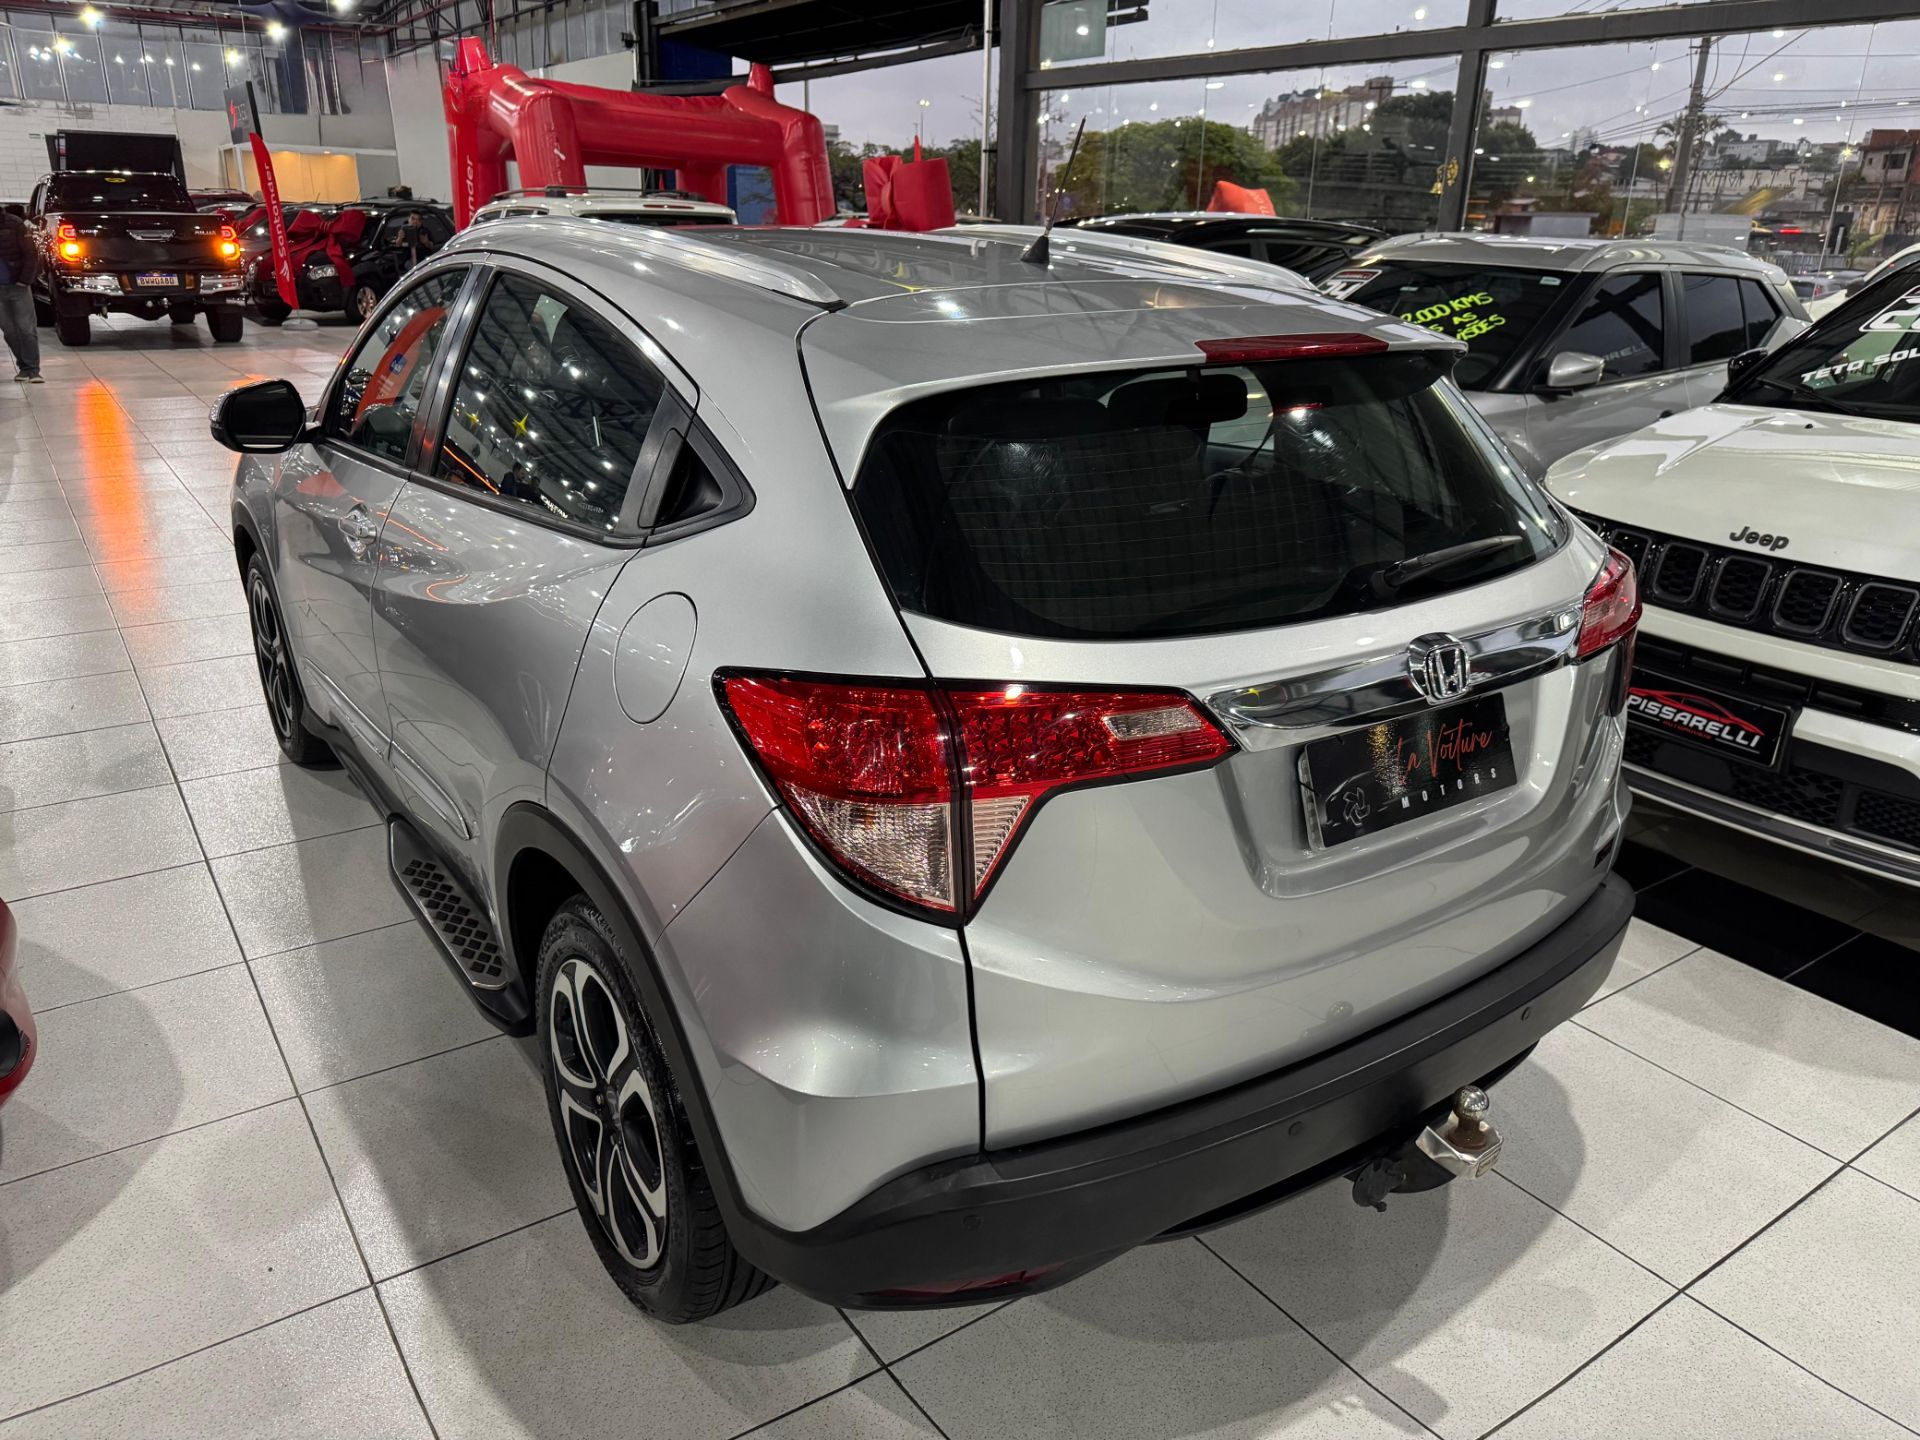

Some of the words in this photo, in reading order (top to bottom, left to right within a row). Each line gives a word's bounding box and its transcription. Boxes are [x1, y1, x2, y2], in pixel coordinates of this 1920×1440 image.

[264, 162, 286, 257] Santander
[1449, 291, 1494, 312] KMS
[1801, 359, 1865, 383] TETO
[1729, 526, 1790, 551] Jeep
[1627, 694, 1761, 748] PISSARELLI
[1427, 718, 1493, 778] Voiture
[1401, 767, 1497, 809] MOTORS
